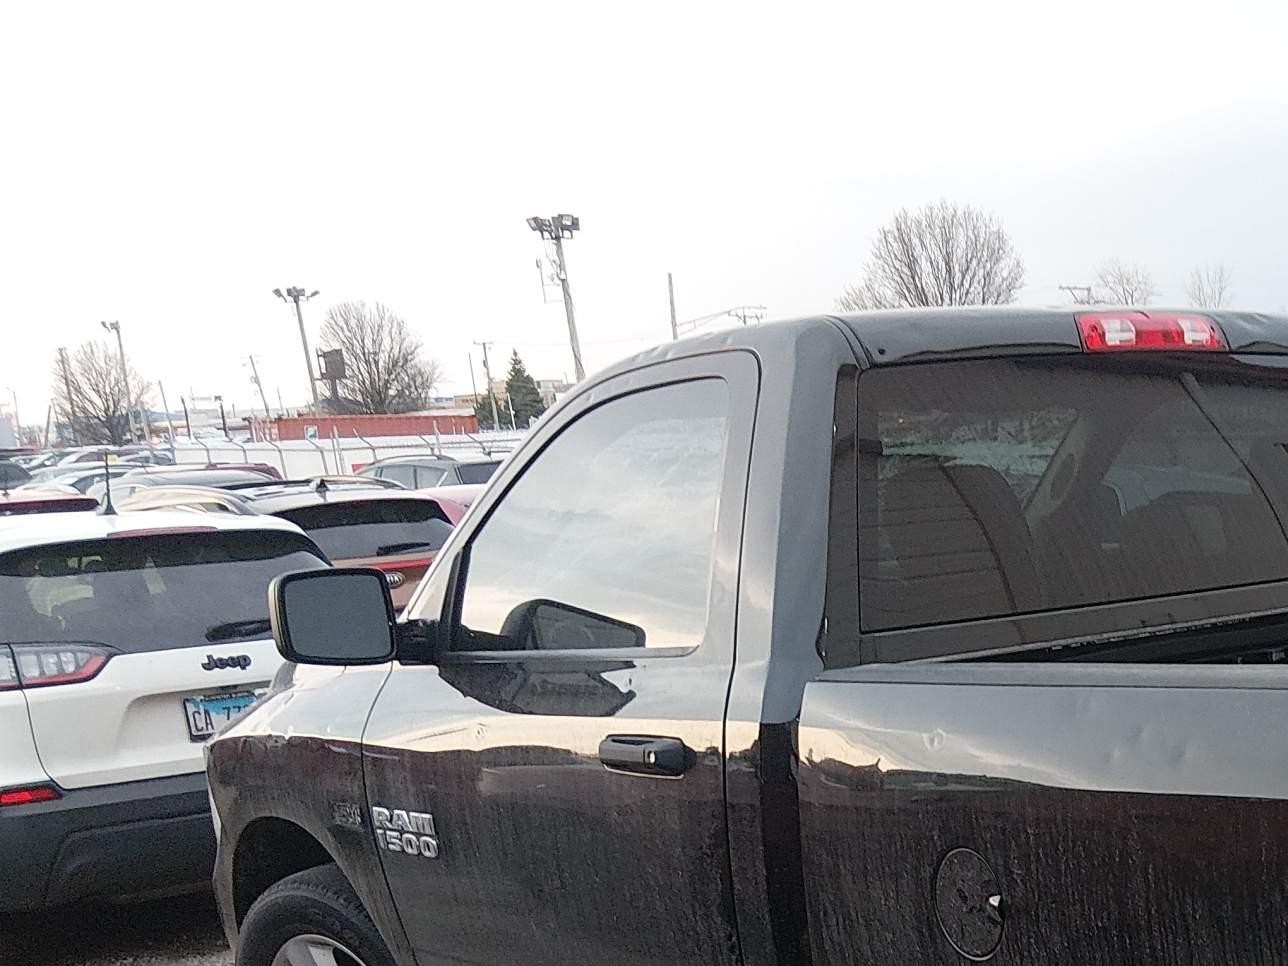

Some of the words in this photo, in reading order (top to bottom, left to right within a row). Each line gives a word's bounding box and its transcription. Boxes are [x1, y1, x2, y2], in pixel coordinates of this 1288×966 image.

[201, 654, 251, 671] Jeep
[192, 708, 214, 731] CA
[372, 806, 435, 835] RAM
[376, 829, 439, 858] 1500
